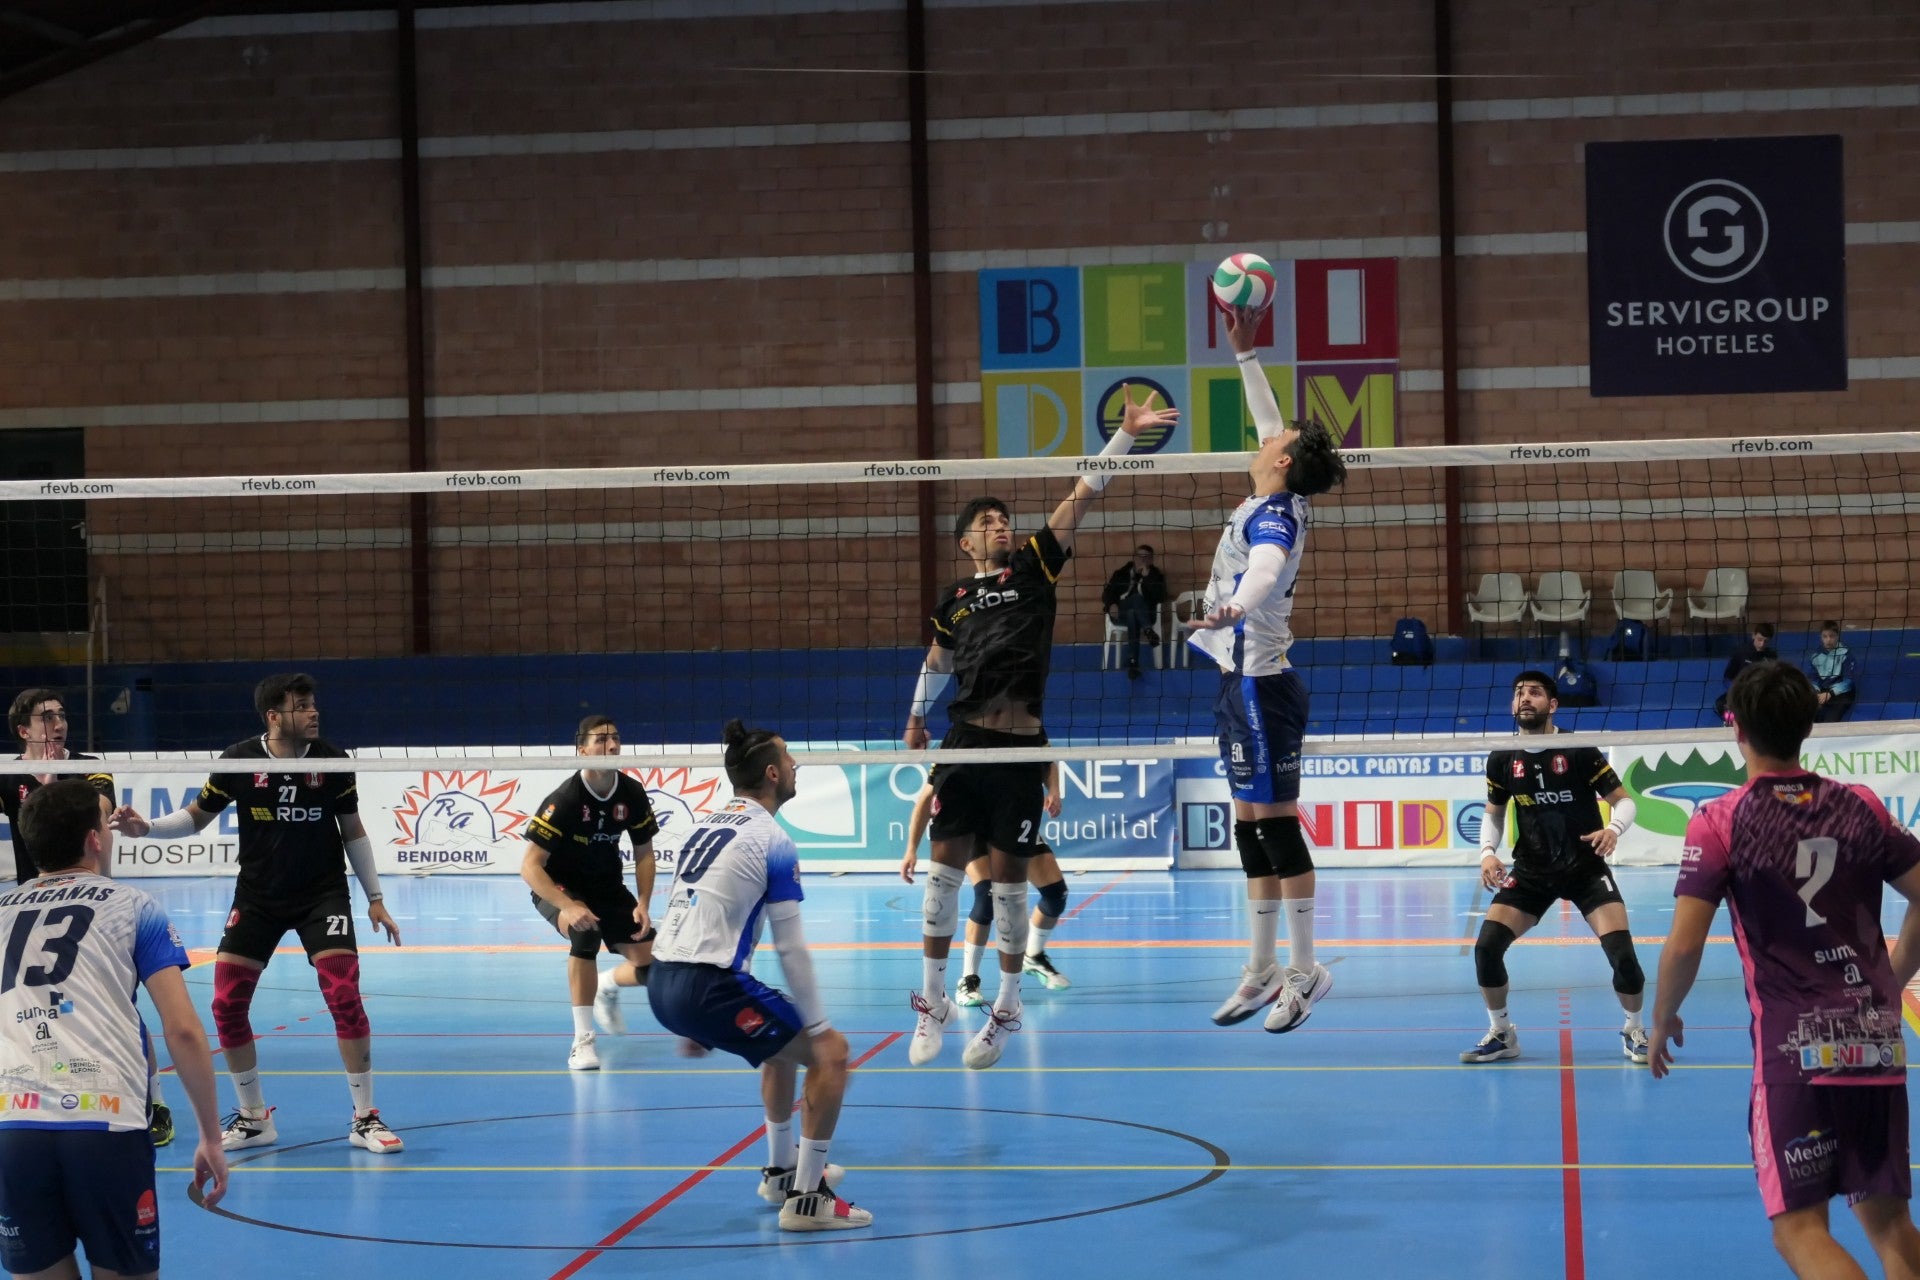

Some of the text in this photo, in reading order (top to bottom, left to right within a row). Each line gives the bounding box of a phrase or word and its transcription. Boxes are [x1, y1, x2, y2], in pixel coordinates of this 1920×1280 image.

[1607, 297, 1829, 327] SERVIGROUP
[1657, 334, 1775, 355] HOTELES
[1510, 444, 1591, 459] rfevb.com
[1731, 438, 1813, 453] rfevb.com
[864, 463, 942, 477] rfevb.com
[1076, 457, 1155, 471] rfevb.com
[446, 473, 521, 486] rfevb.com
[653, 469, 731, 482] rfevb.com
[40, 482, 114, 494] rfevb.com
[242, 478, 316, 491] rfevb.com
[1365, 755, 1430, 774] PLAYAS
[1444, 754, 1463, 773] DE
[1535, 772, 1545, 789] 1
[279, 785, 297, 803] 27
[1534, 789, 1574, 805] RDS
[277, 806, 323, 822] RDS
[1017, 819, 1032, 843] 2
[1045, 813, 1159, 846] qualitat
[397, 850, 488, 862] BENIDORM
[674, 827, 737, 884] 10
[1600, 875, 1613, 892] 1
[1795, 836, 1838, 928] 2
[326, 915, 348, 936] 27
[1, 904, 95, 994] 13
[16, 1006, 59, 1024] suma
